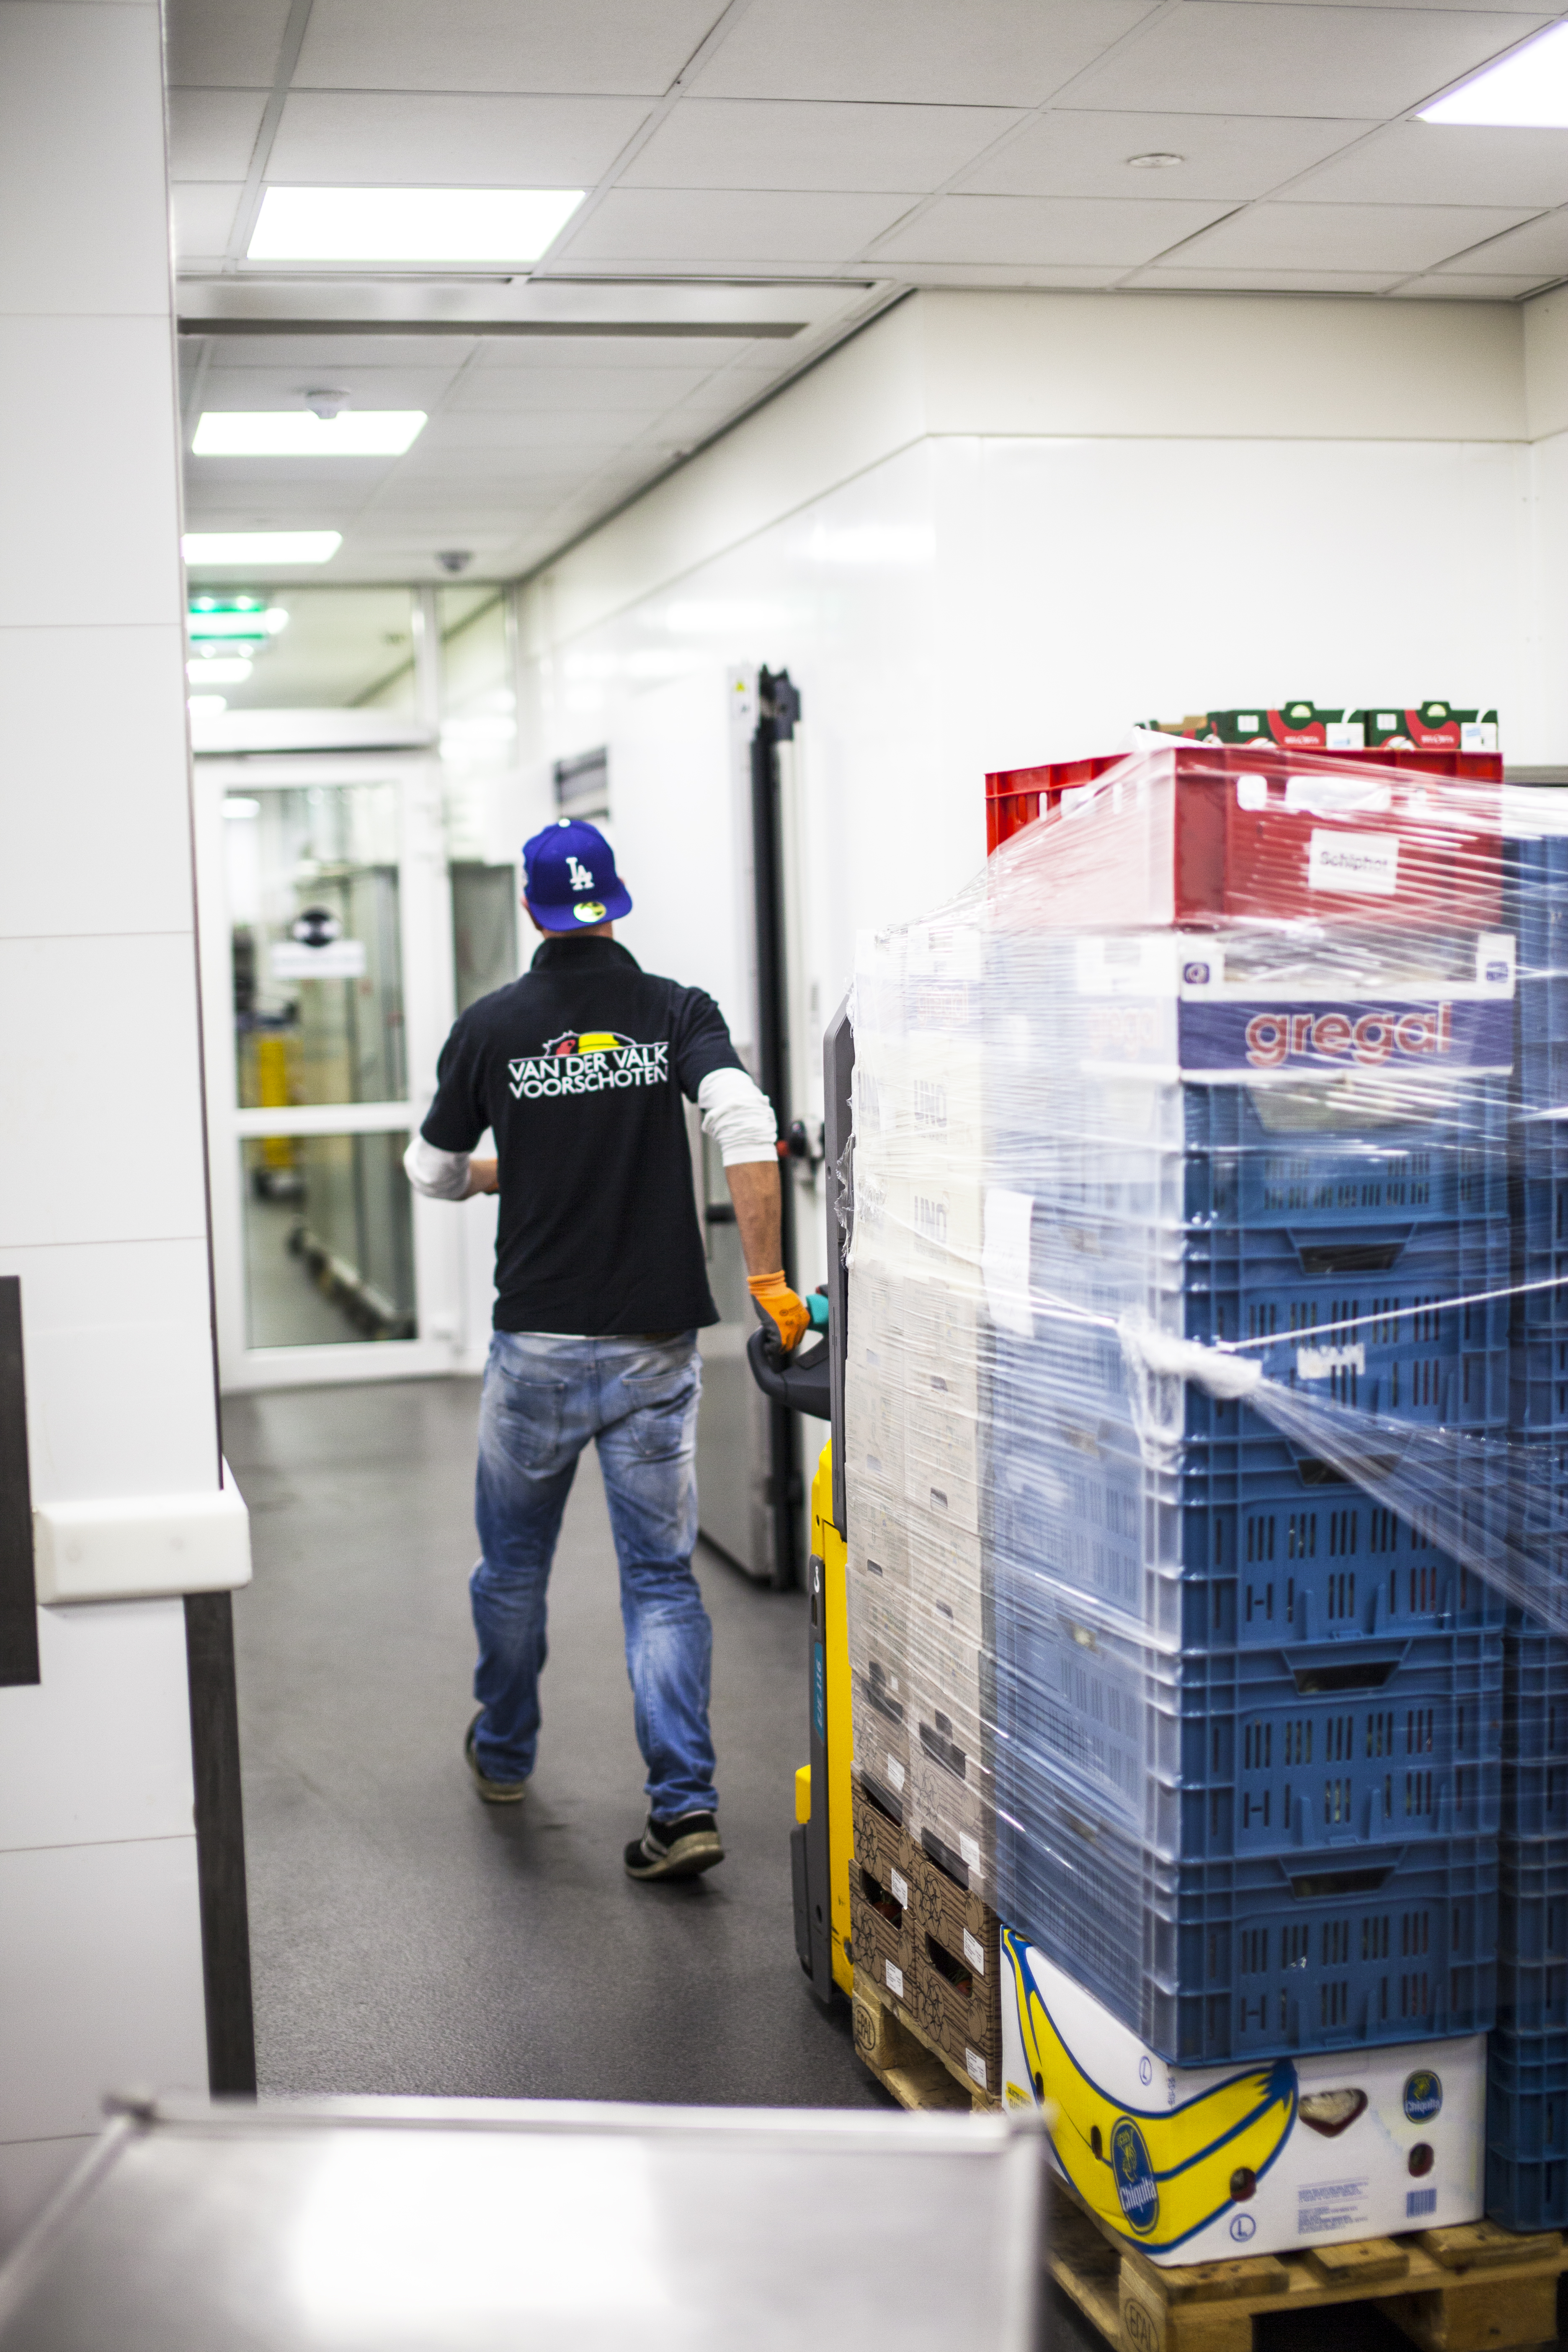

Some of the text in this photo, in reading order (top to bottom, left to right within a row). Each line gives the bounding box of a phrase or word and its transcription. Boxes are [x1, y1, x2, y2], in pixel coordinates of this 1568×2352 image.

[566, 857, 595, 891] LA
[1246, 1001, 1453, 1068] gregal
[508, 1046, 668, 1081] VAN DER VALK
[509, 1064, 668, 1100] VOORSCHOTEN
[856, 2009, 872, 2046] EPAL
[1404, 2098, 1440, 2114] Chiquita
[1119, 2175, 1158, 2213] Chiquita
